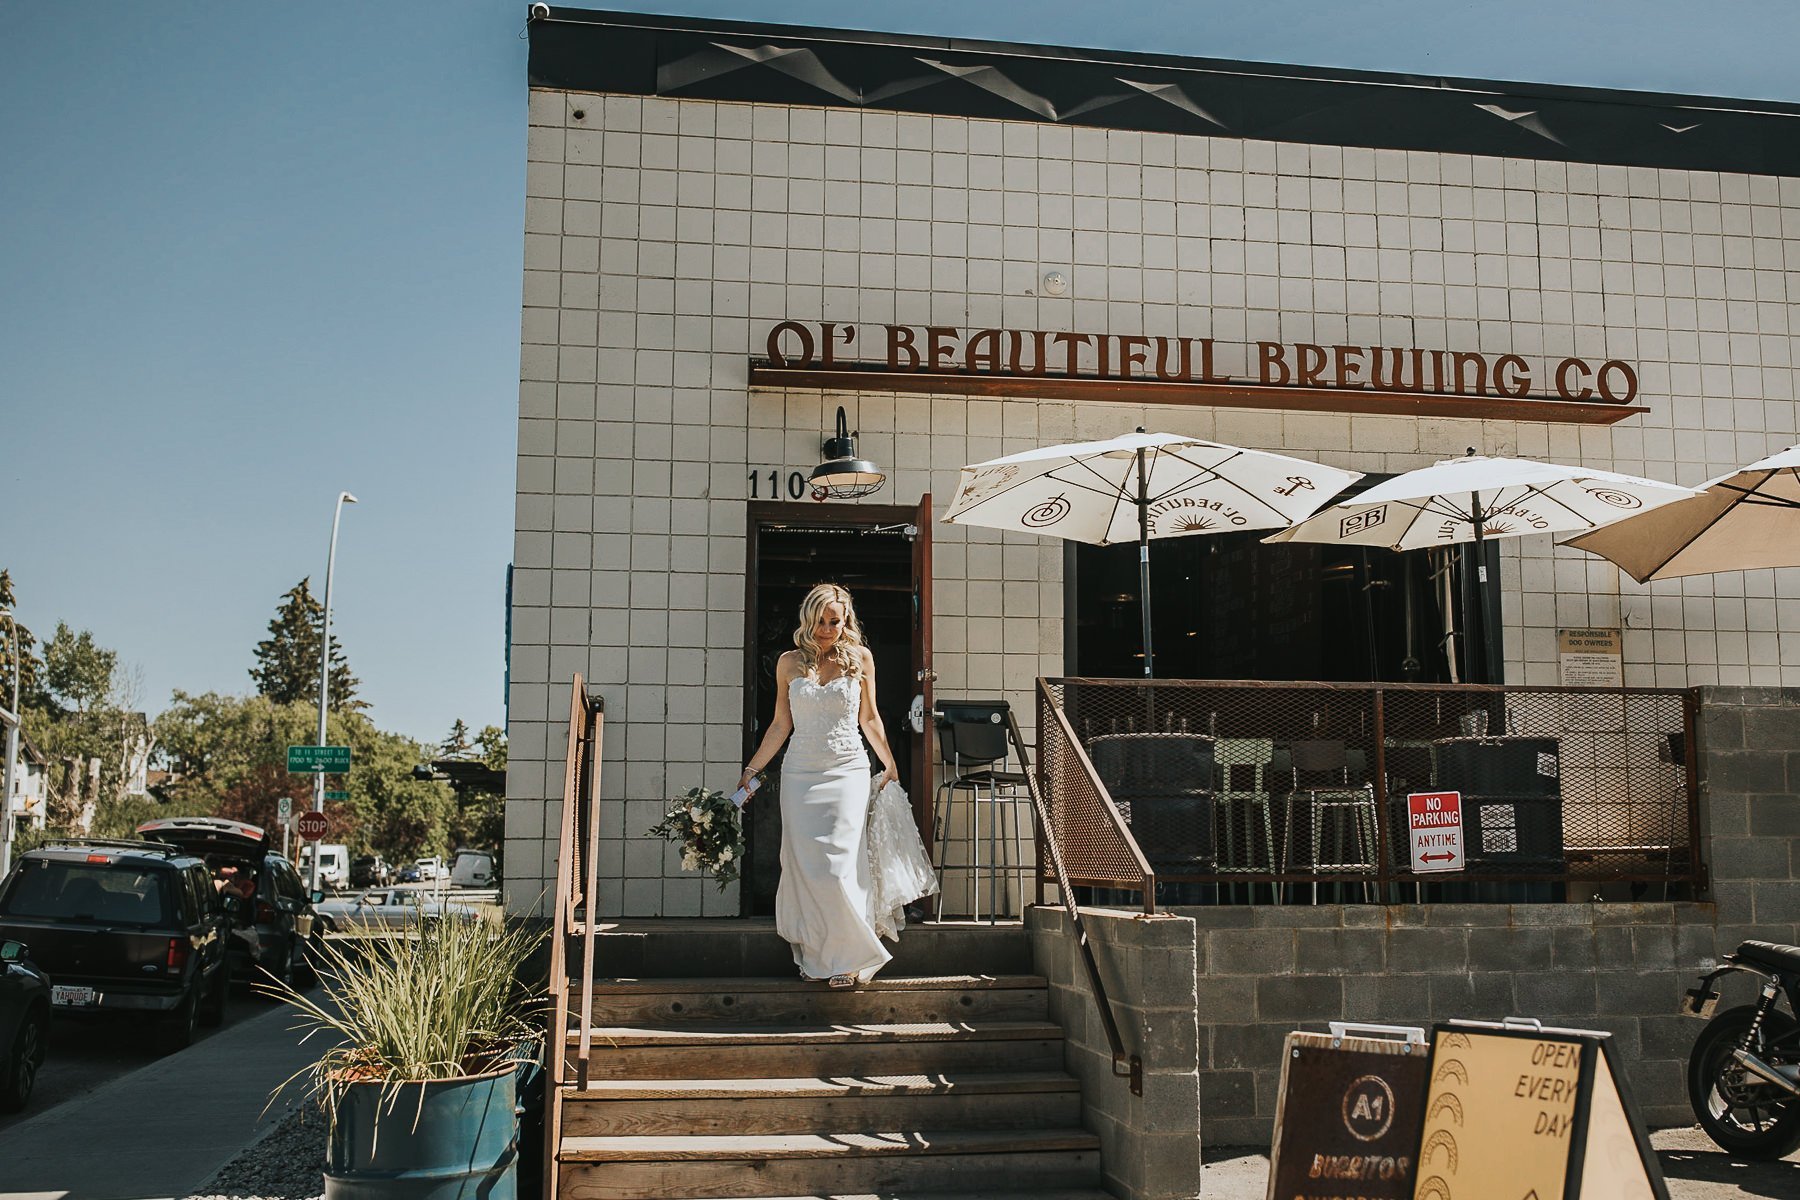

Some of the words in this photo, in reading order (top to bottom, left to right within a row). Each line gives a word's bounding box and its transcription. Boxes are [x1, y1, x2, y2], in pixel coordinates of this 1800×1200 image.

[767, 321, 855, 369] OL'
[885, 325, 1231, 384] BEAUTIFUL
[1256, 340, 1532, 398] BREWING
[1555, 357, 1638, 405] CO
[1568, 630, 1612, 638] RESPONSIBLE
[1584, 639, 1613, 647] OWNERS
[1425, 797, 1442, 811] NO
[299, 820, 327, 833] STOP
[1412, 810, 1459, 827] PARKING
[1417, 833, 1457, 848] ANYTIME
[1530, 1042, 1581, 1070] OPEN
[1514, 1074, 1579, 1104] EVERY
[1351, 1093, 1384, 1121] A1
[1533, 1110, 1575, 1139] DAY
